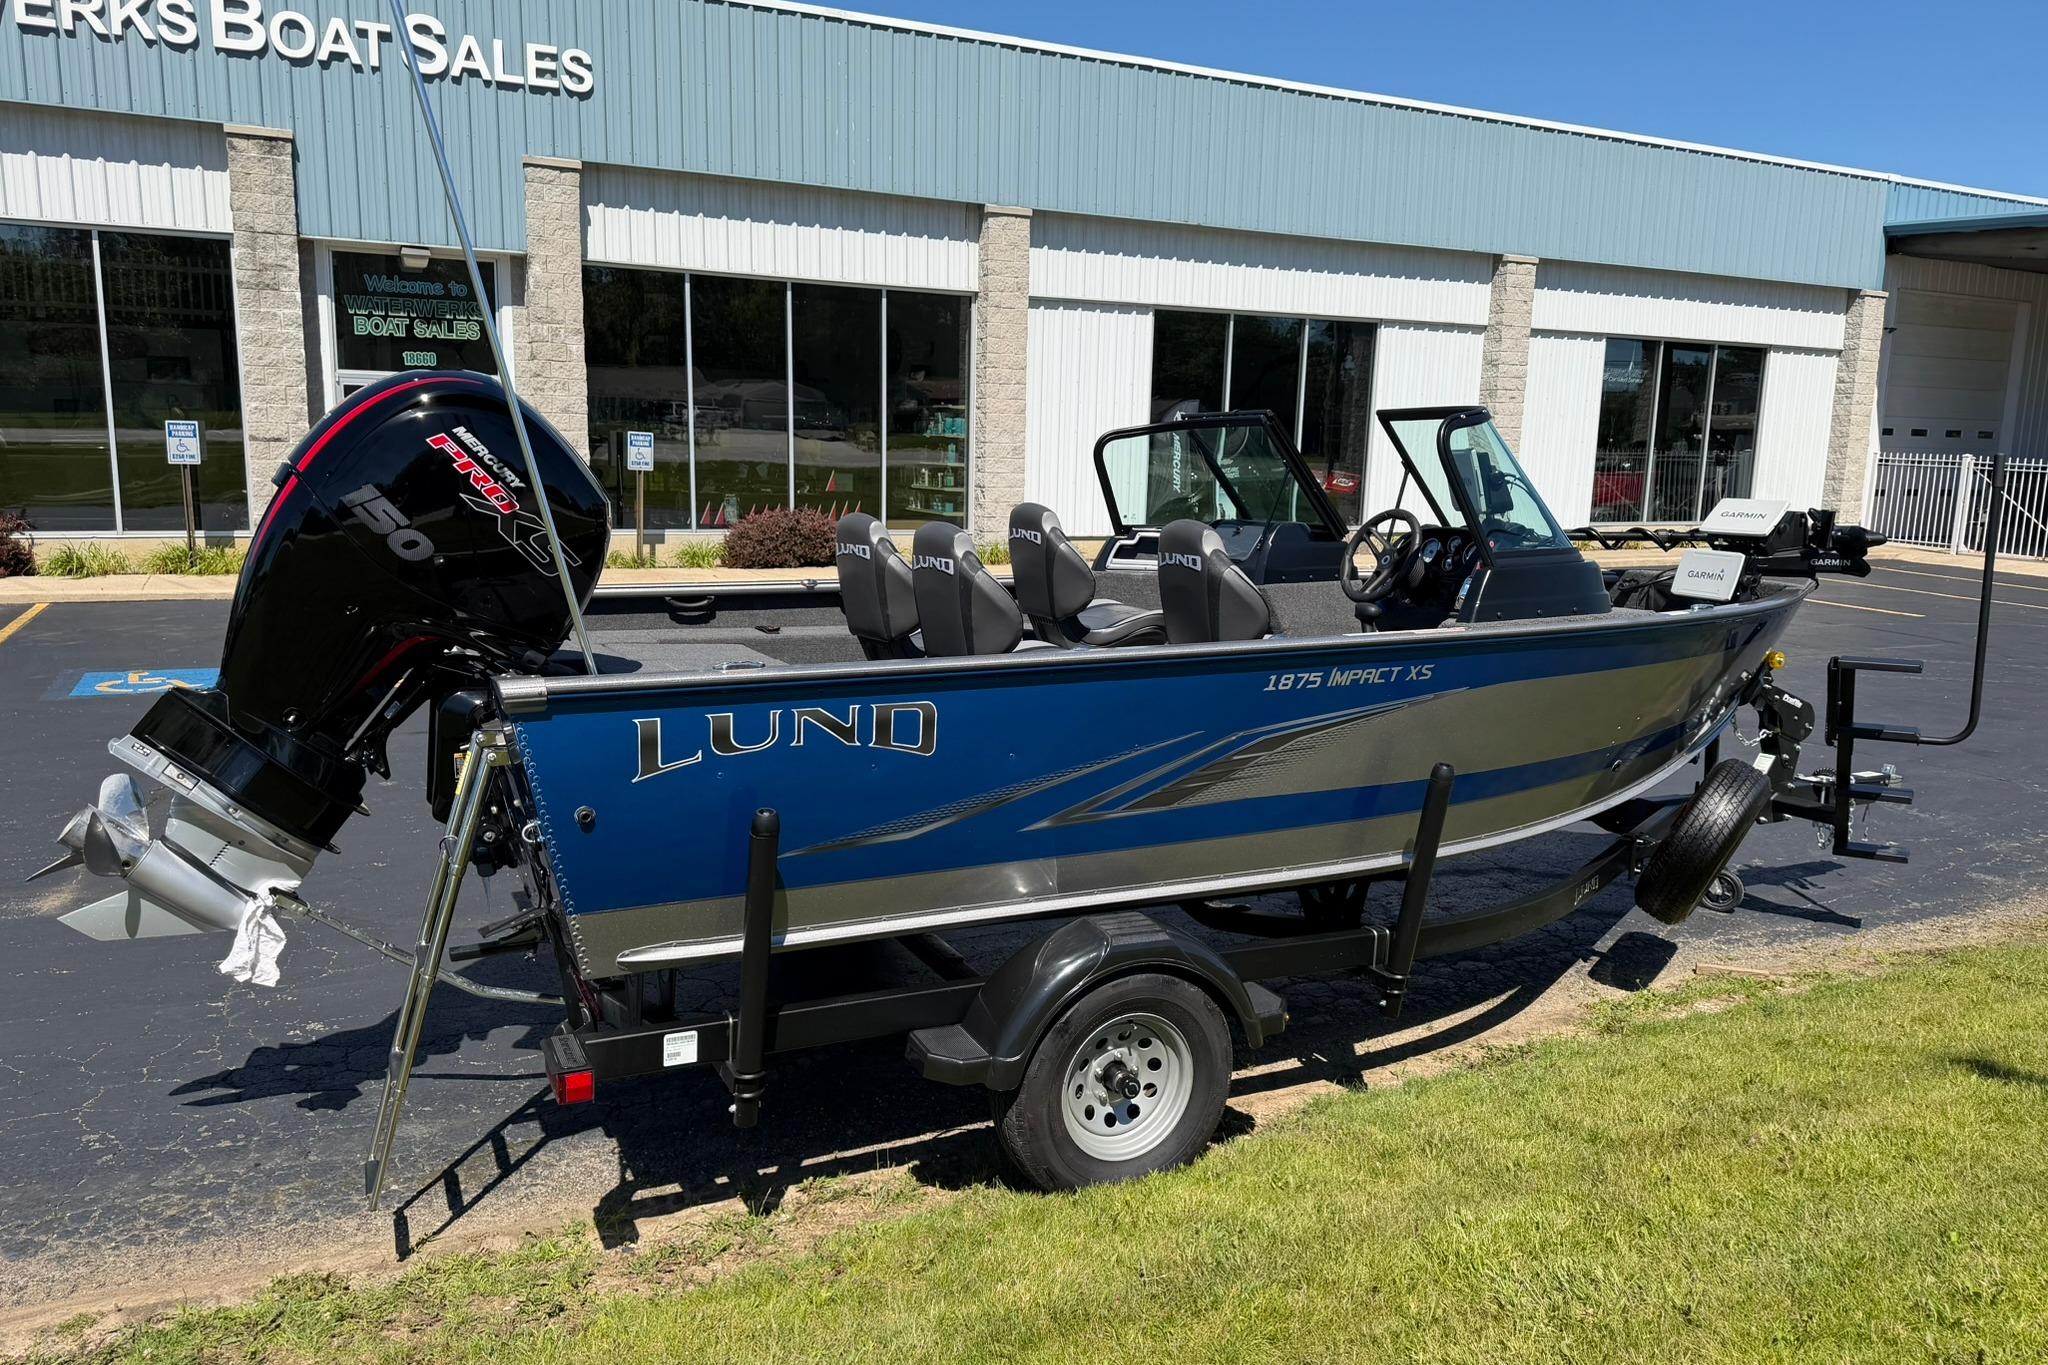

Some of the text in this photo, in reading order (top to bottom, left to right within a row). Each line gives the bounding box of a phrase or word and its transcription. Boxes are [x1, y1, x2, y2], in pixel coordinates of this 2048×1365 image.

[211, 0, 391, 69] BOAT
[401, 13, 594, 94] SALES
[364, 273, 468, 297] Welcome to
[344, 295, 484, 321] WATERWERKS
[353, 316, 481, 341] BOAT SALES
[403, 351, 437, 367] 18660
[452, 426, 526, 489] MERCURY
[1172, 432, 1182, 494] MERCURY
[426, 432, 520, 514] PRO
[340, 483, 435, 562] 150
[1720, 511, 1768, 520] GARMIN
[1009, 527, 1042, 545] LUND
[836, 542, 871, 560] LUND
[1158, 551, 1202, 572] LUND
[1810, 558, 1851, 567] GARMIN
[913, 554, 955, 576] LUND
[1687, 570, 1725, 581] GARMIN
[1263, 664, 1436, 692] 1875 IMPACT XS
[632, 701, 937, 783] LUND
